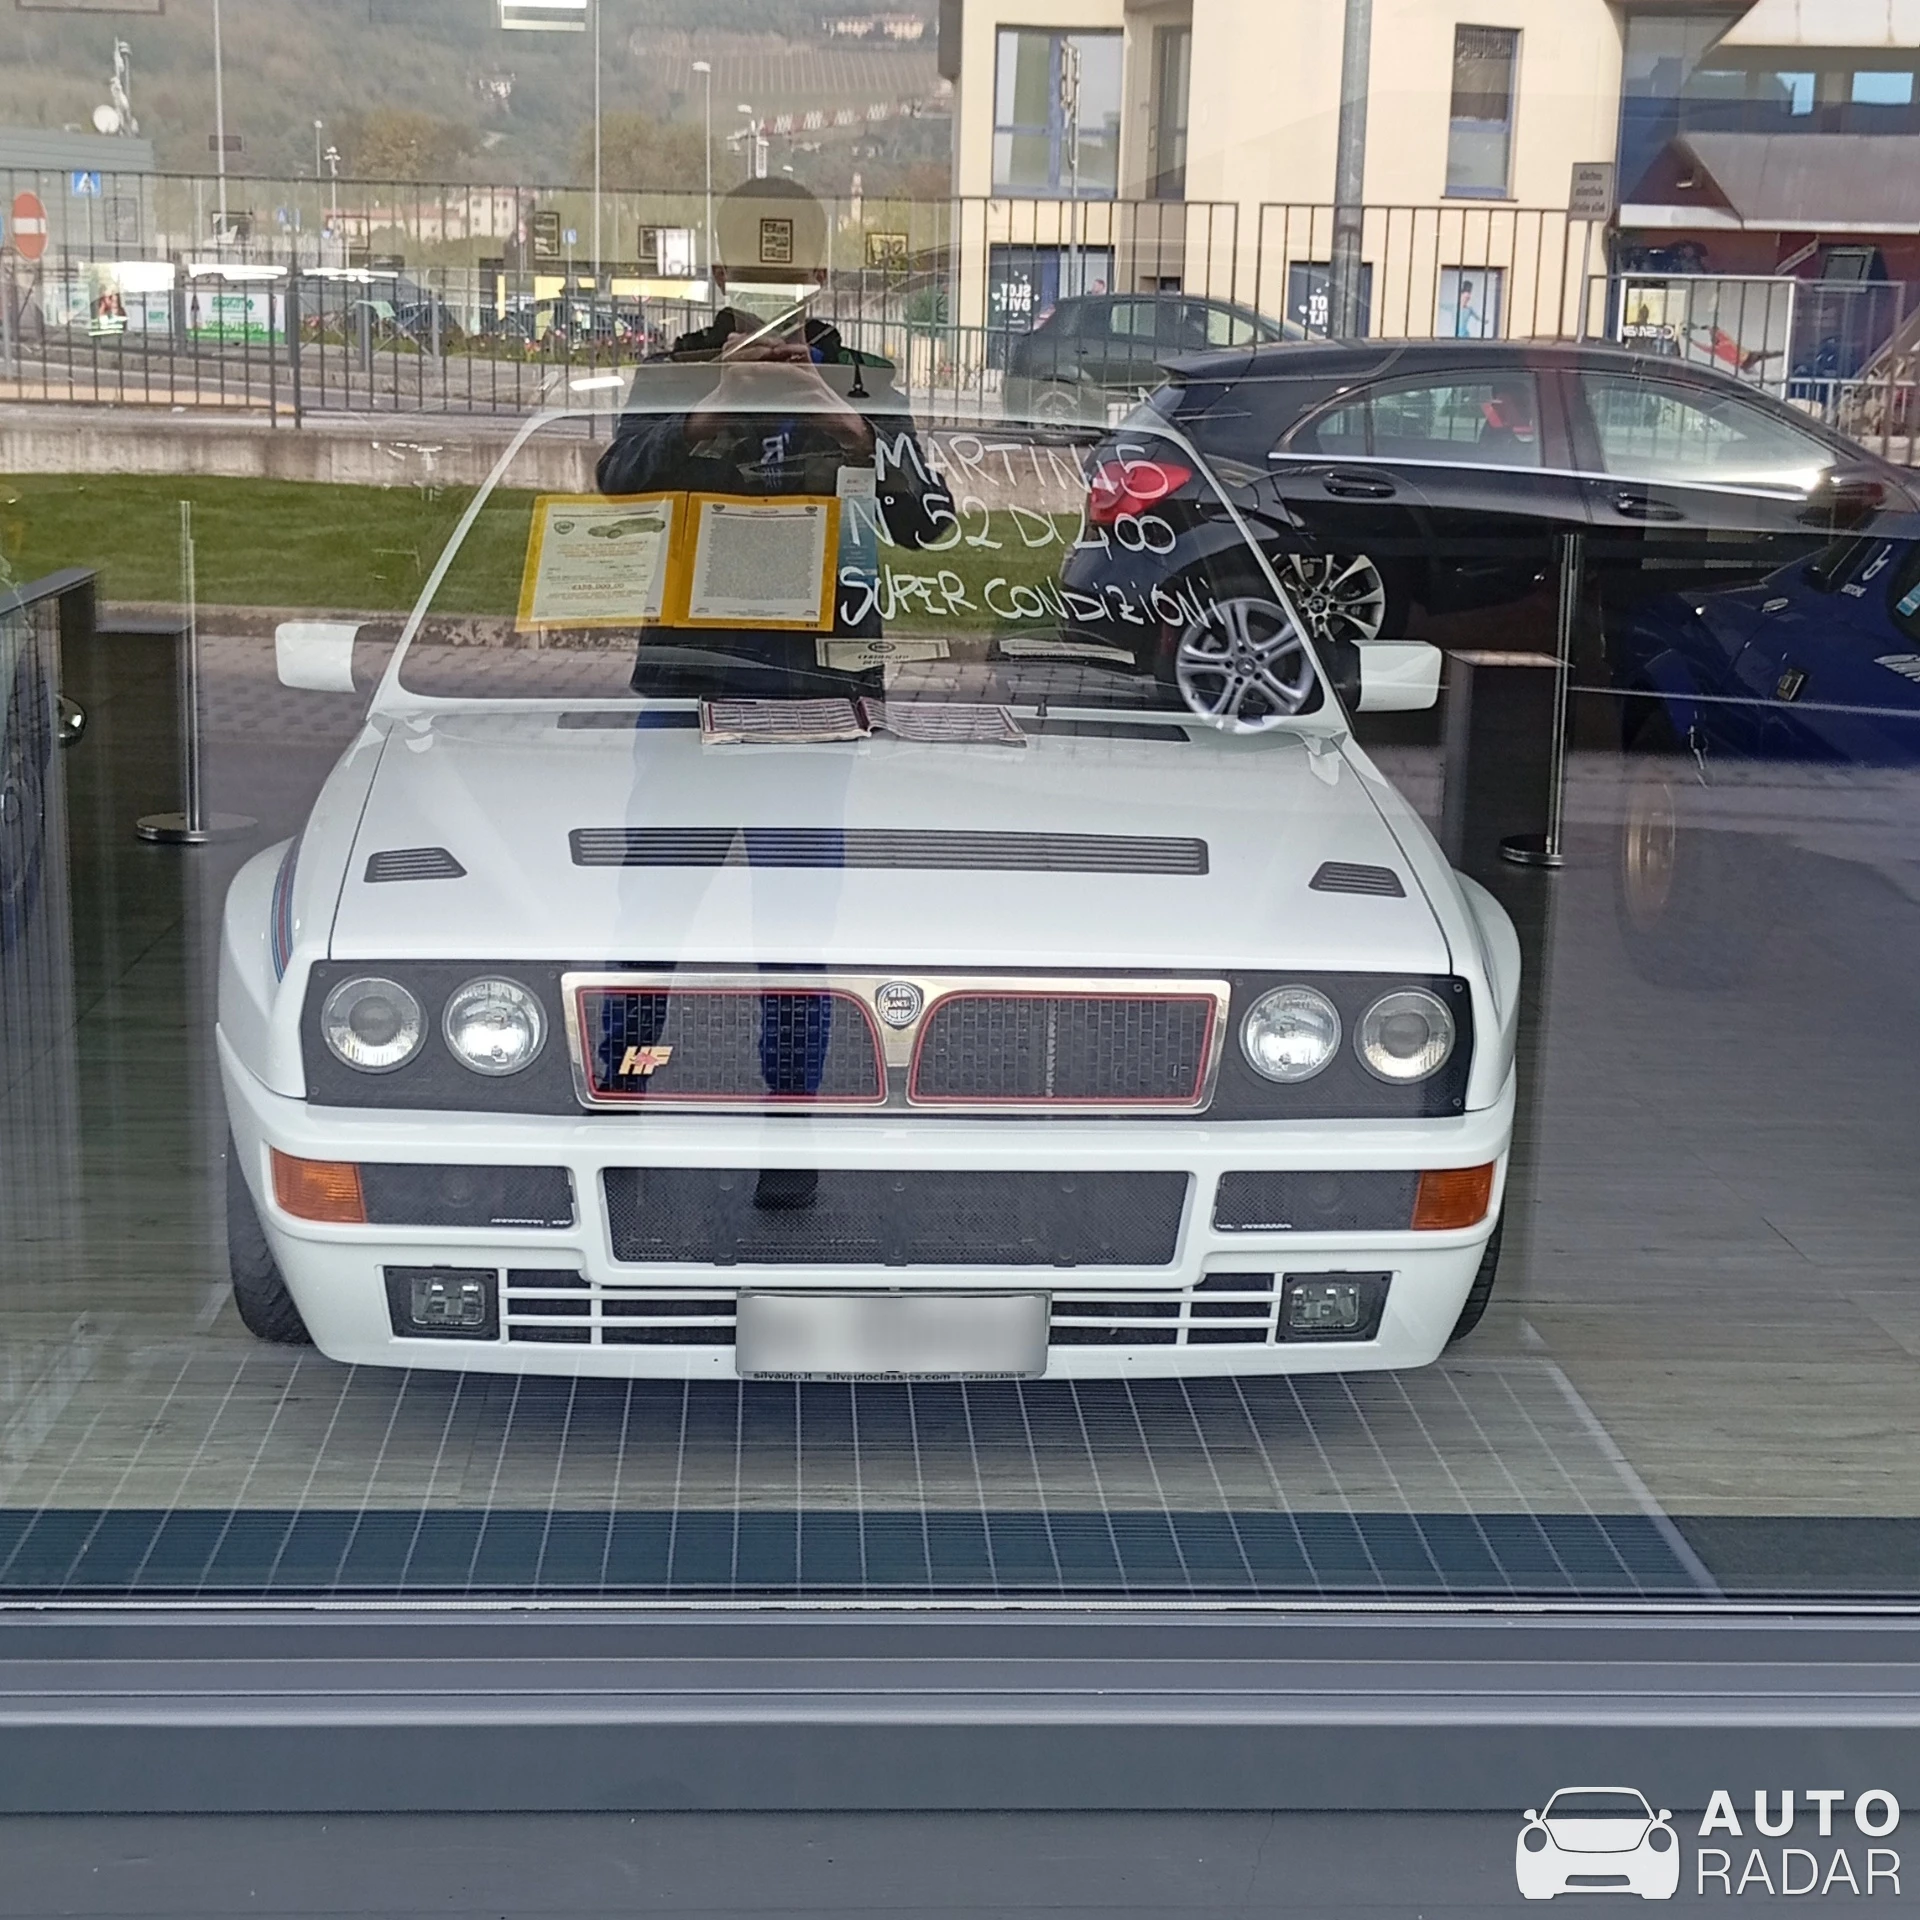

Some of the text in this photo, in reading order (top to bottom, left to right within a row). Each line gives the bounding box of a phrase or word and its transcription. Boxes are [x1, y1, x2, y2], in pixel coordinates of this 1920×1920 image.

[874, 431, 1169, 500] MARTINI 5
[915, 492, 1003, 551] 52
[838, 563, 978, 627] SUPER
[618, 1045, 675, 1076] HF
[752, 1371, 813, 1381] silvauto.it
